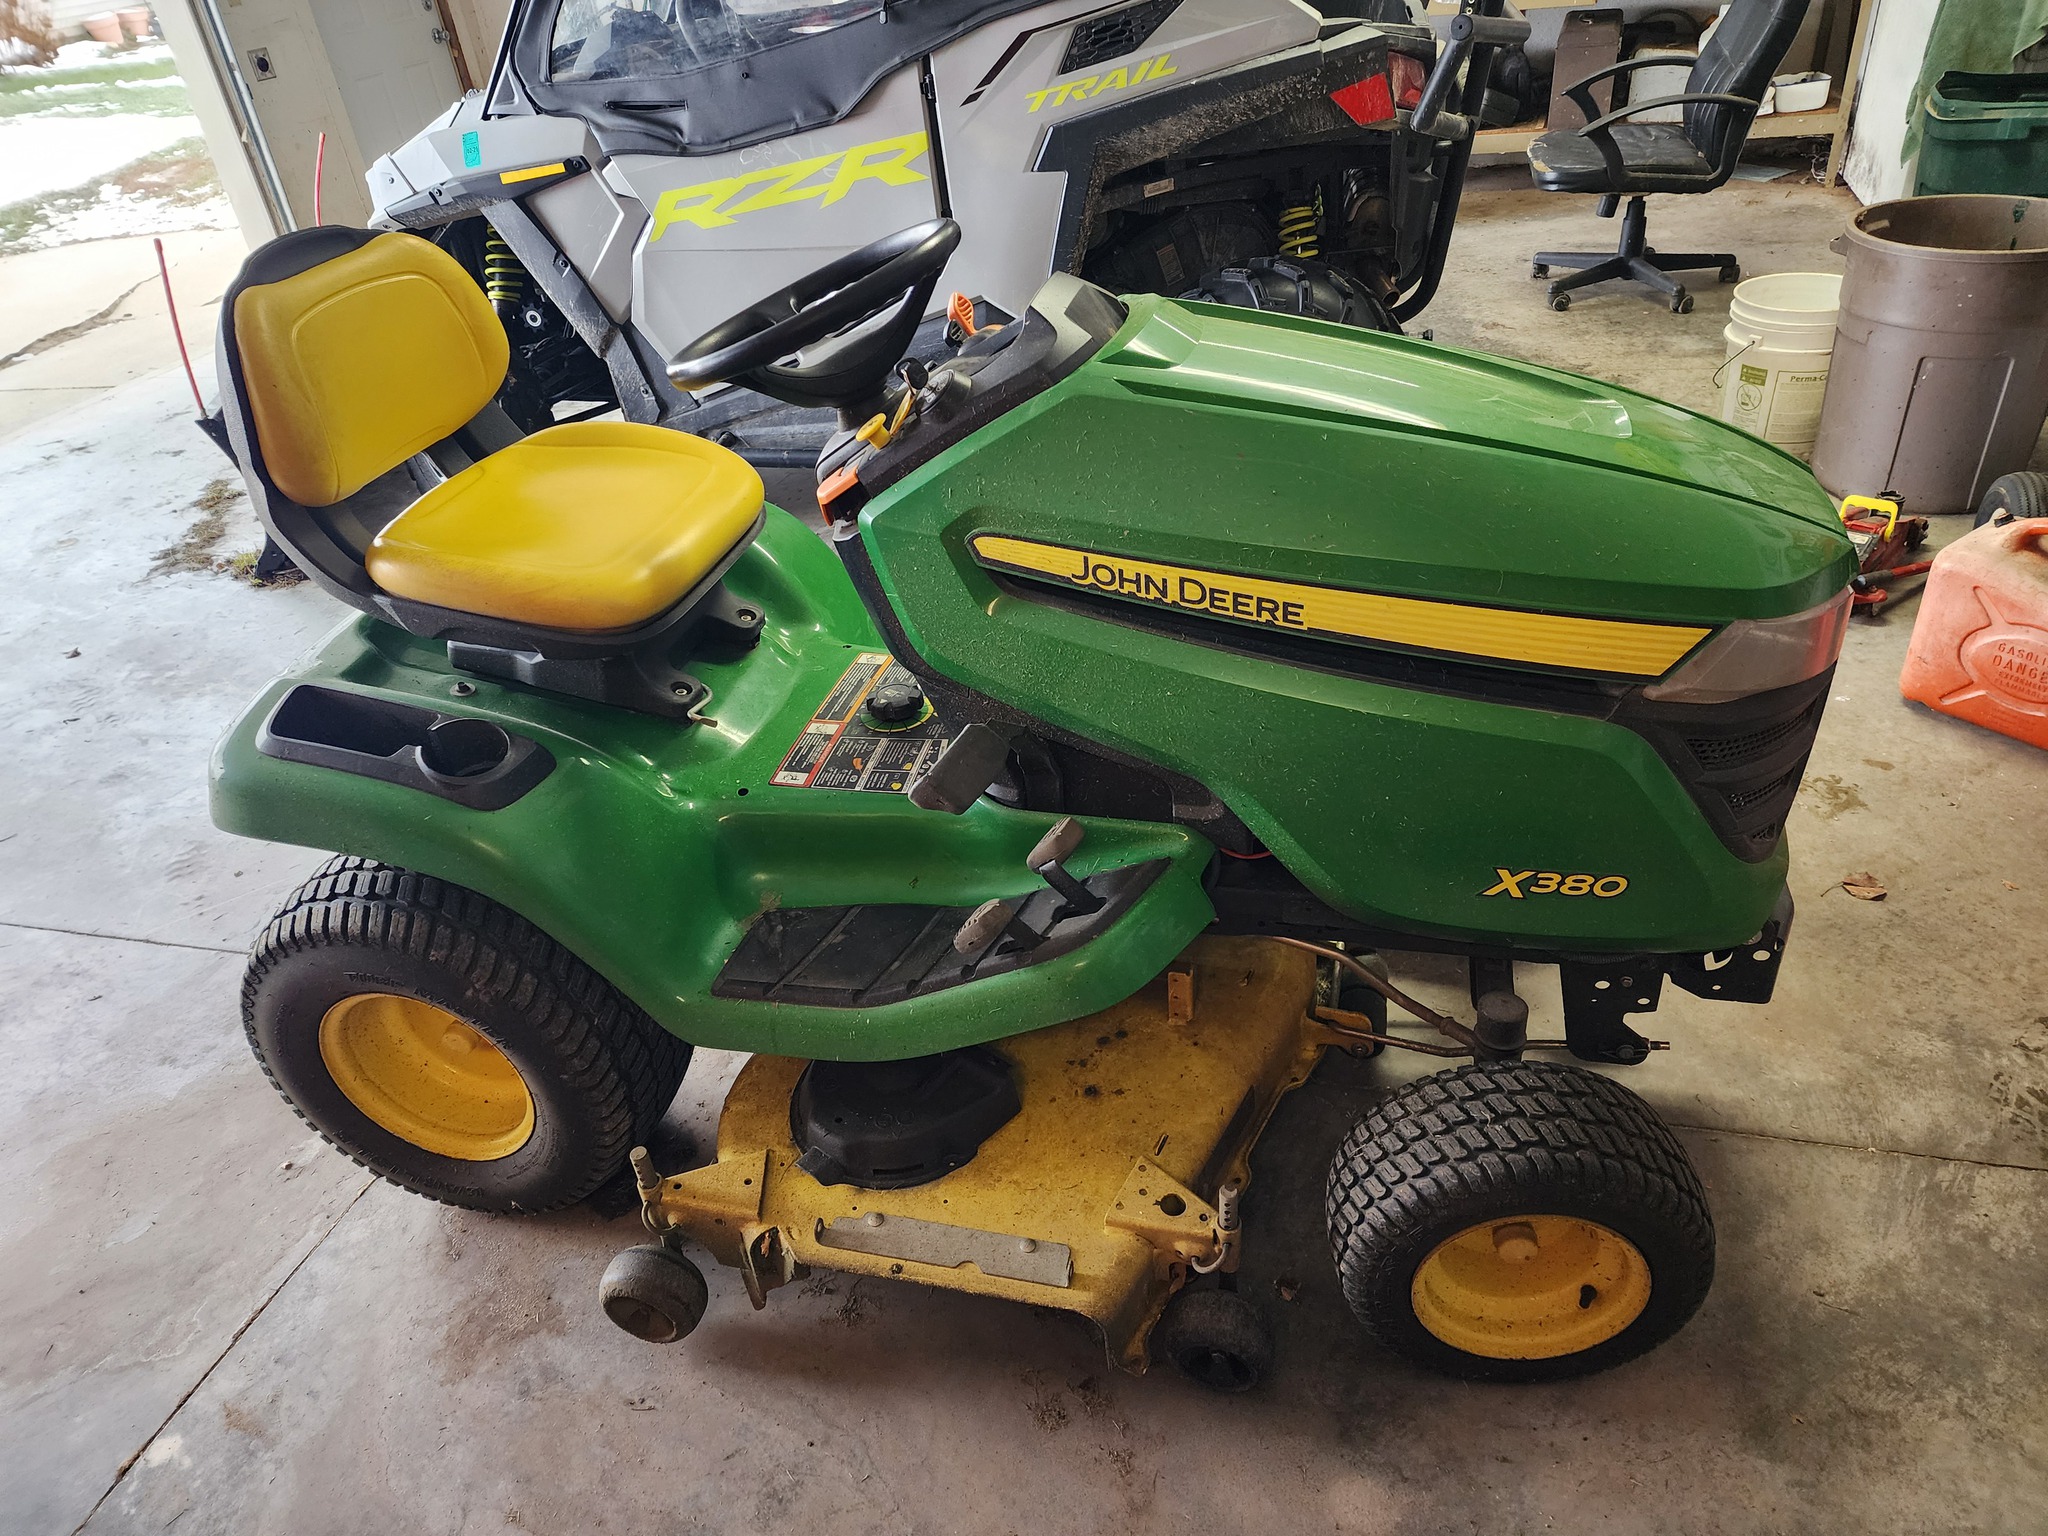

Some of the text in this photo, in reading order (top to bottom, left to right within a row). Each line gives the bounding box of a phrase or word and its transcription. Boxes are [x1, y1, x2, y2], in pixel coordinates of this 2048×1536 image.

[1025, 53, 1179, 114] TRAIL
[649, 131, 930, 243] RZR
[1071, 555, 1305, 626] JOHN DEERE
[1998, 642, 2048, 668] GASOLI
[1477, 867, 1630, 899] X380
